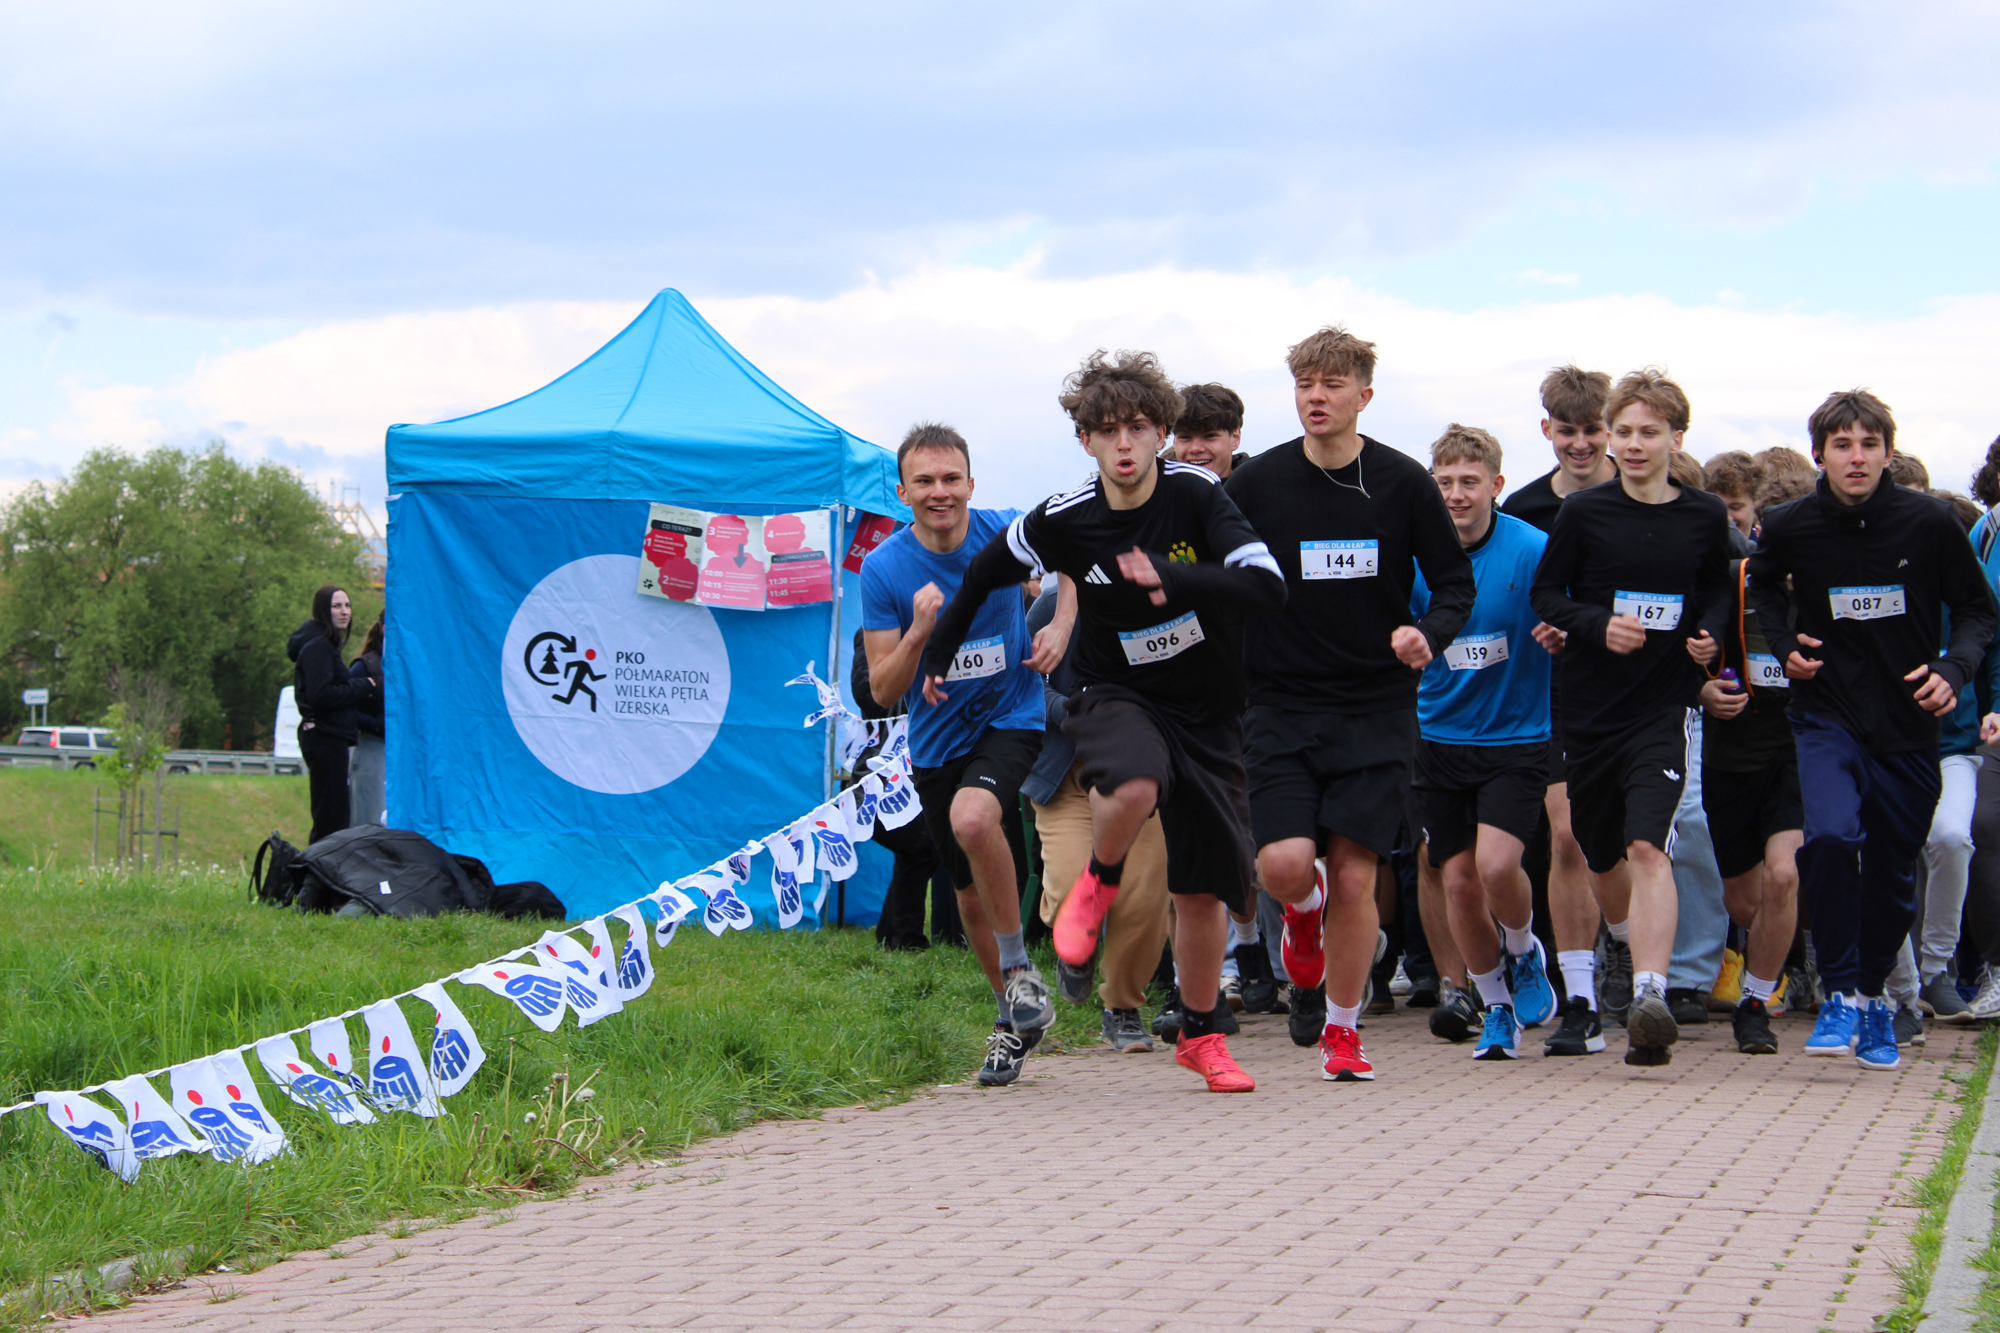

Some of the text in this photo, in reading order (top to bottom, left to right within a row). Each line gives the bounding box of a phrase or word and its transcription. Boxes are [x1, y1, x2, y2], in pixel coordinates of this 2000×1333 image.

[672, 525, 692, 533] TERAZ?
[708, 527, 715, 536] 3
[647, 538, 652, 547] 1
[1326, 554, 1355, 568] 144
[704, 569, 724, 578] 10:00
[662, 575, 669, 585] 2
[703, 581, 722, 589] 10:15
[769, 577, 788, 585] 11:30
[701, 591, 721, 600] 10:30
[770, 589, 789, 597] 11:45
[1852, 597, 1882, 611] 087
[1637, 605, 1678, 621] 167 C
[1131, 630, 1149, 639] BIEG
[1150, 624, 1165, 634] DLA
[1171, 617, 1184, 628] ŁAP
[978, 640, 991, 649] ŁAP
[1146, 628, 1197, 653] 096 C
[616, 651, 645, 665] PKO
[1465, 647, 1488, 660] 159
[954, 653, 1001, 671] 160 C
[615, 665, 709, 684] PÓŁMARATON
[1764, 666, 1782, 678] 08
[615, 684, 709, 703] WIELKA PĘTLA
[615, 700, 670, 715] IZERSKA
